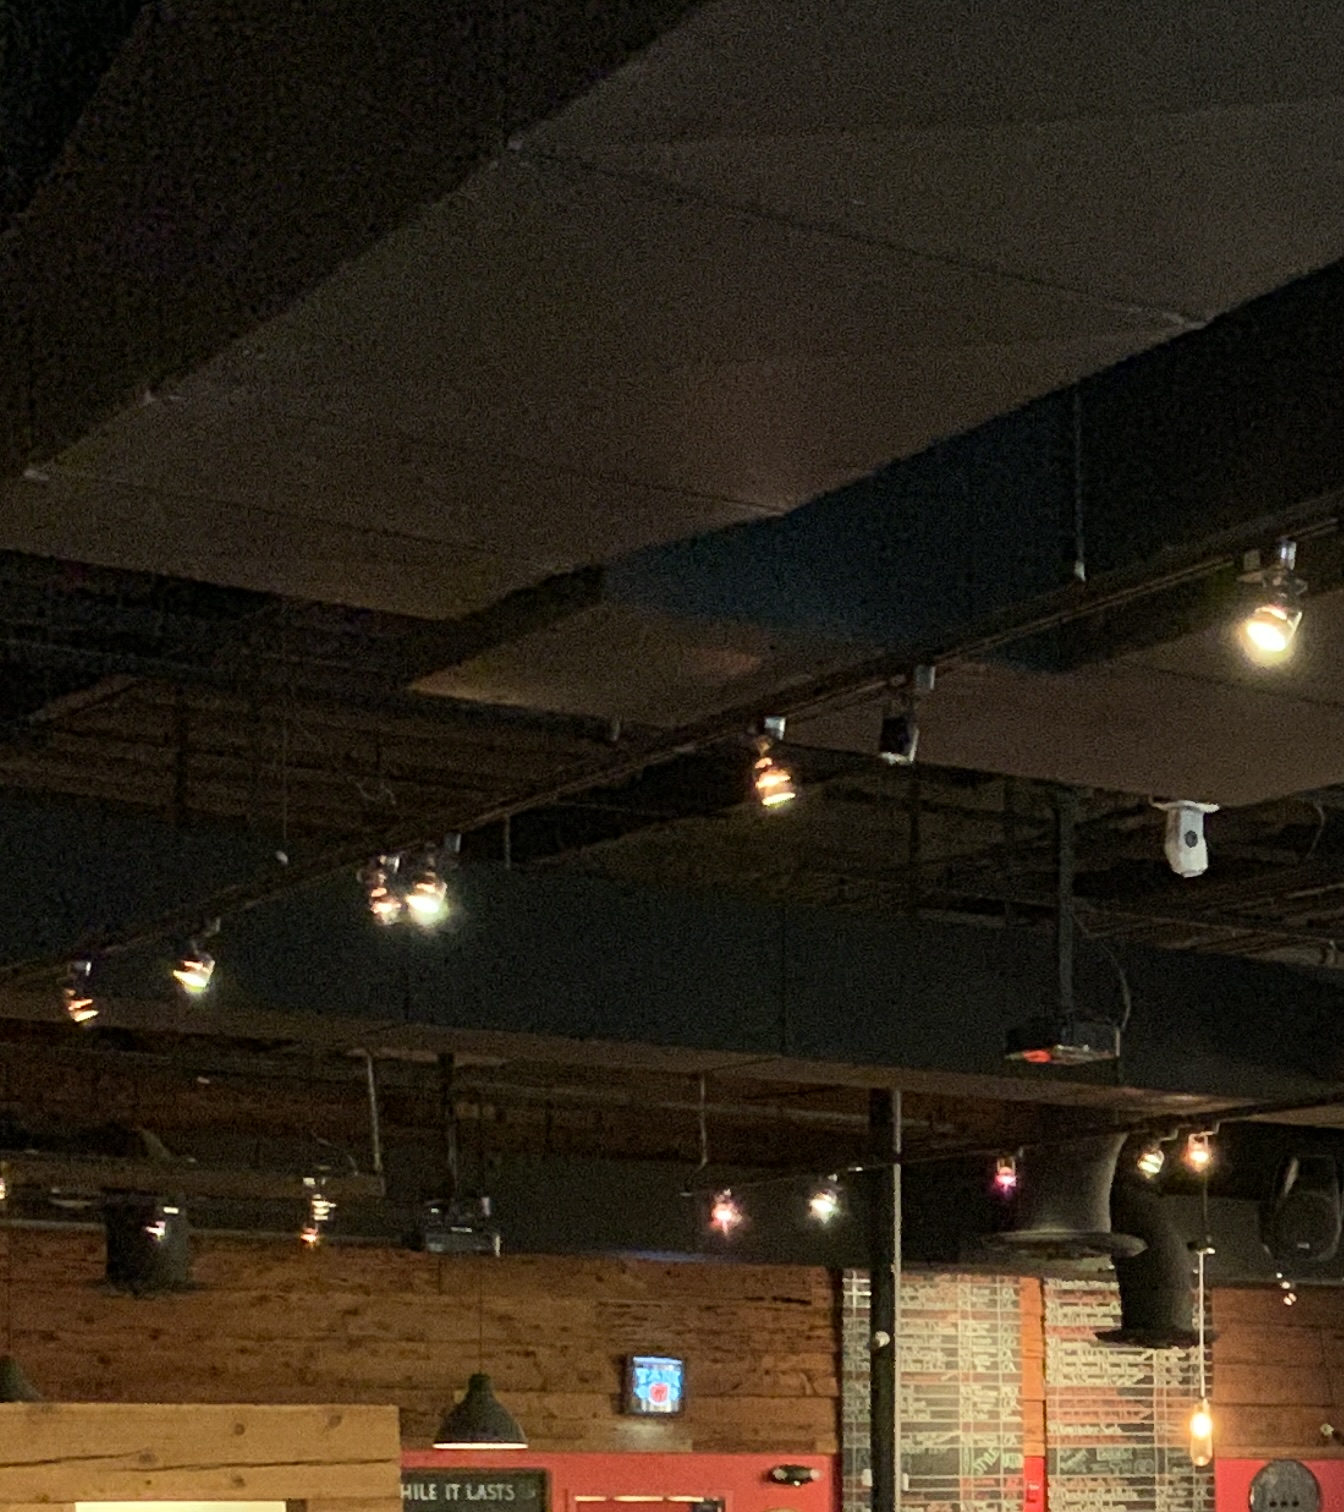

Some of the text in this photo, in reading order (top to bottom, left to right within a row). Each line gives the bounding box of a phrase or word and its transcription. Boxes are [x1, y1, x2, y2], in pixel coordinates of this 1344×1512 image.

[400, 1483, 515, 1501] HILE IT LASTS
